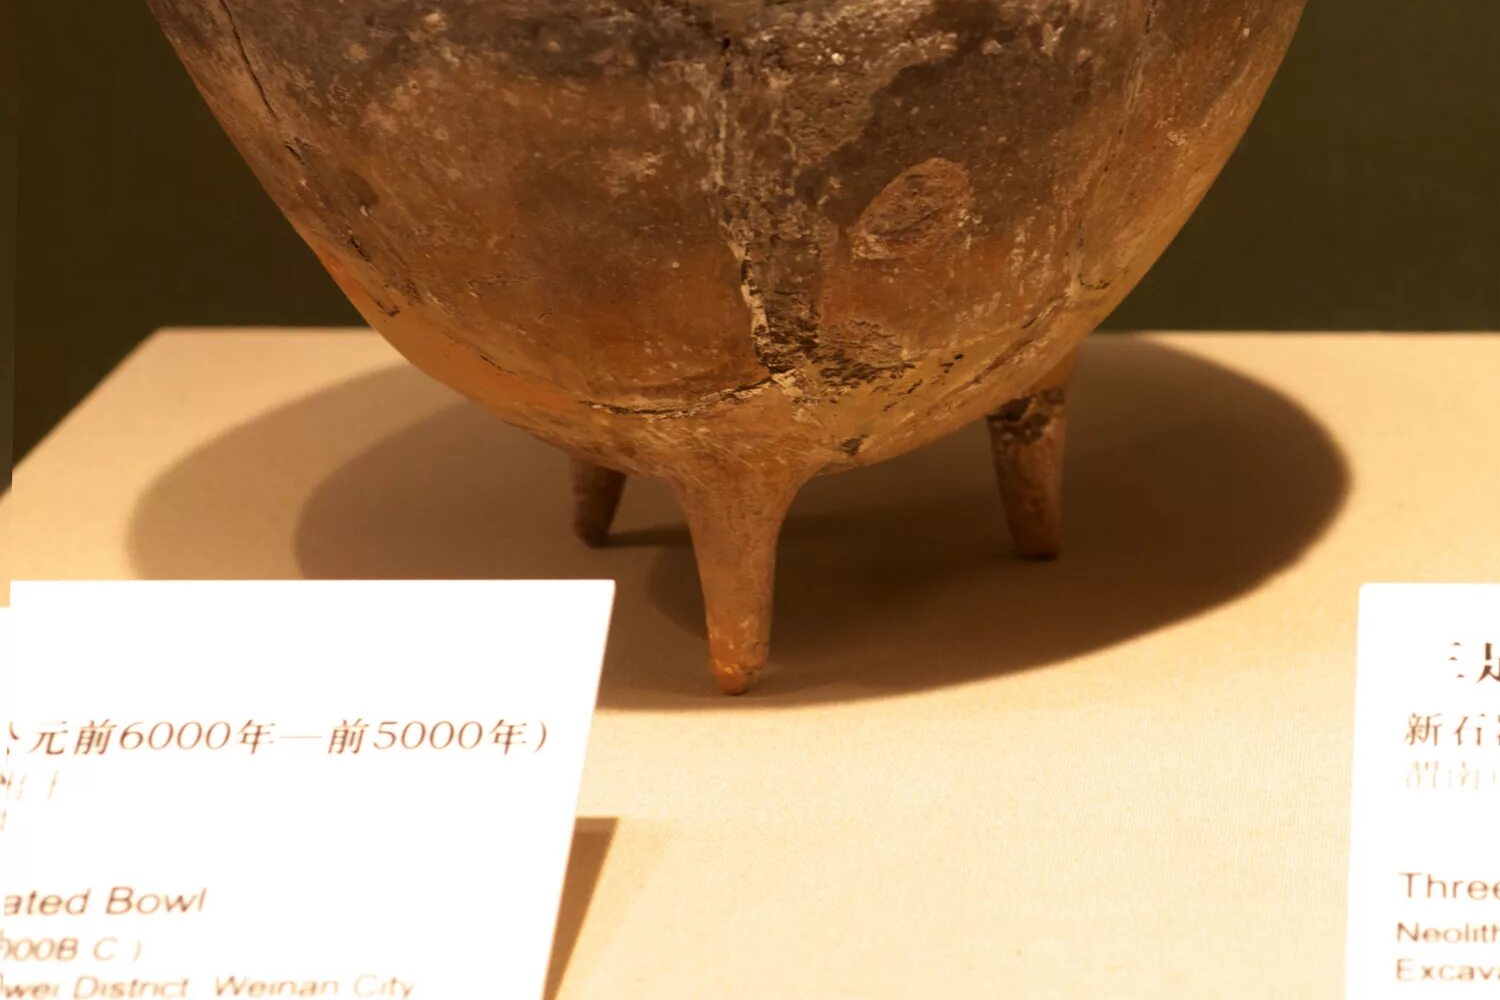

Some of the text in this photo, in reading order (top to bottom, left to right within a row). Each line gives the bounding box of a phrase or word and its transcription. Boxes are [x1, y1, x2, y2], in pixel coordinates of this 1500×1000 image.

[103, 884, 209, 917] Bowl
[0, 971, 61, 1000] wei
[351, 972, 417, 1000] City
